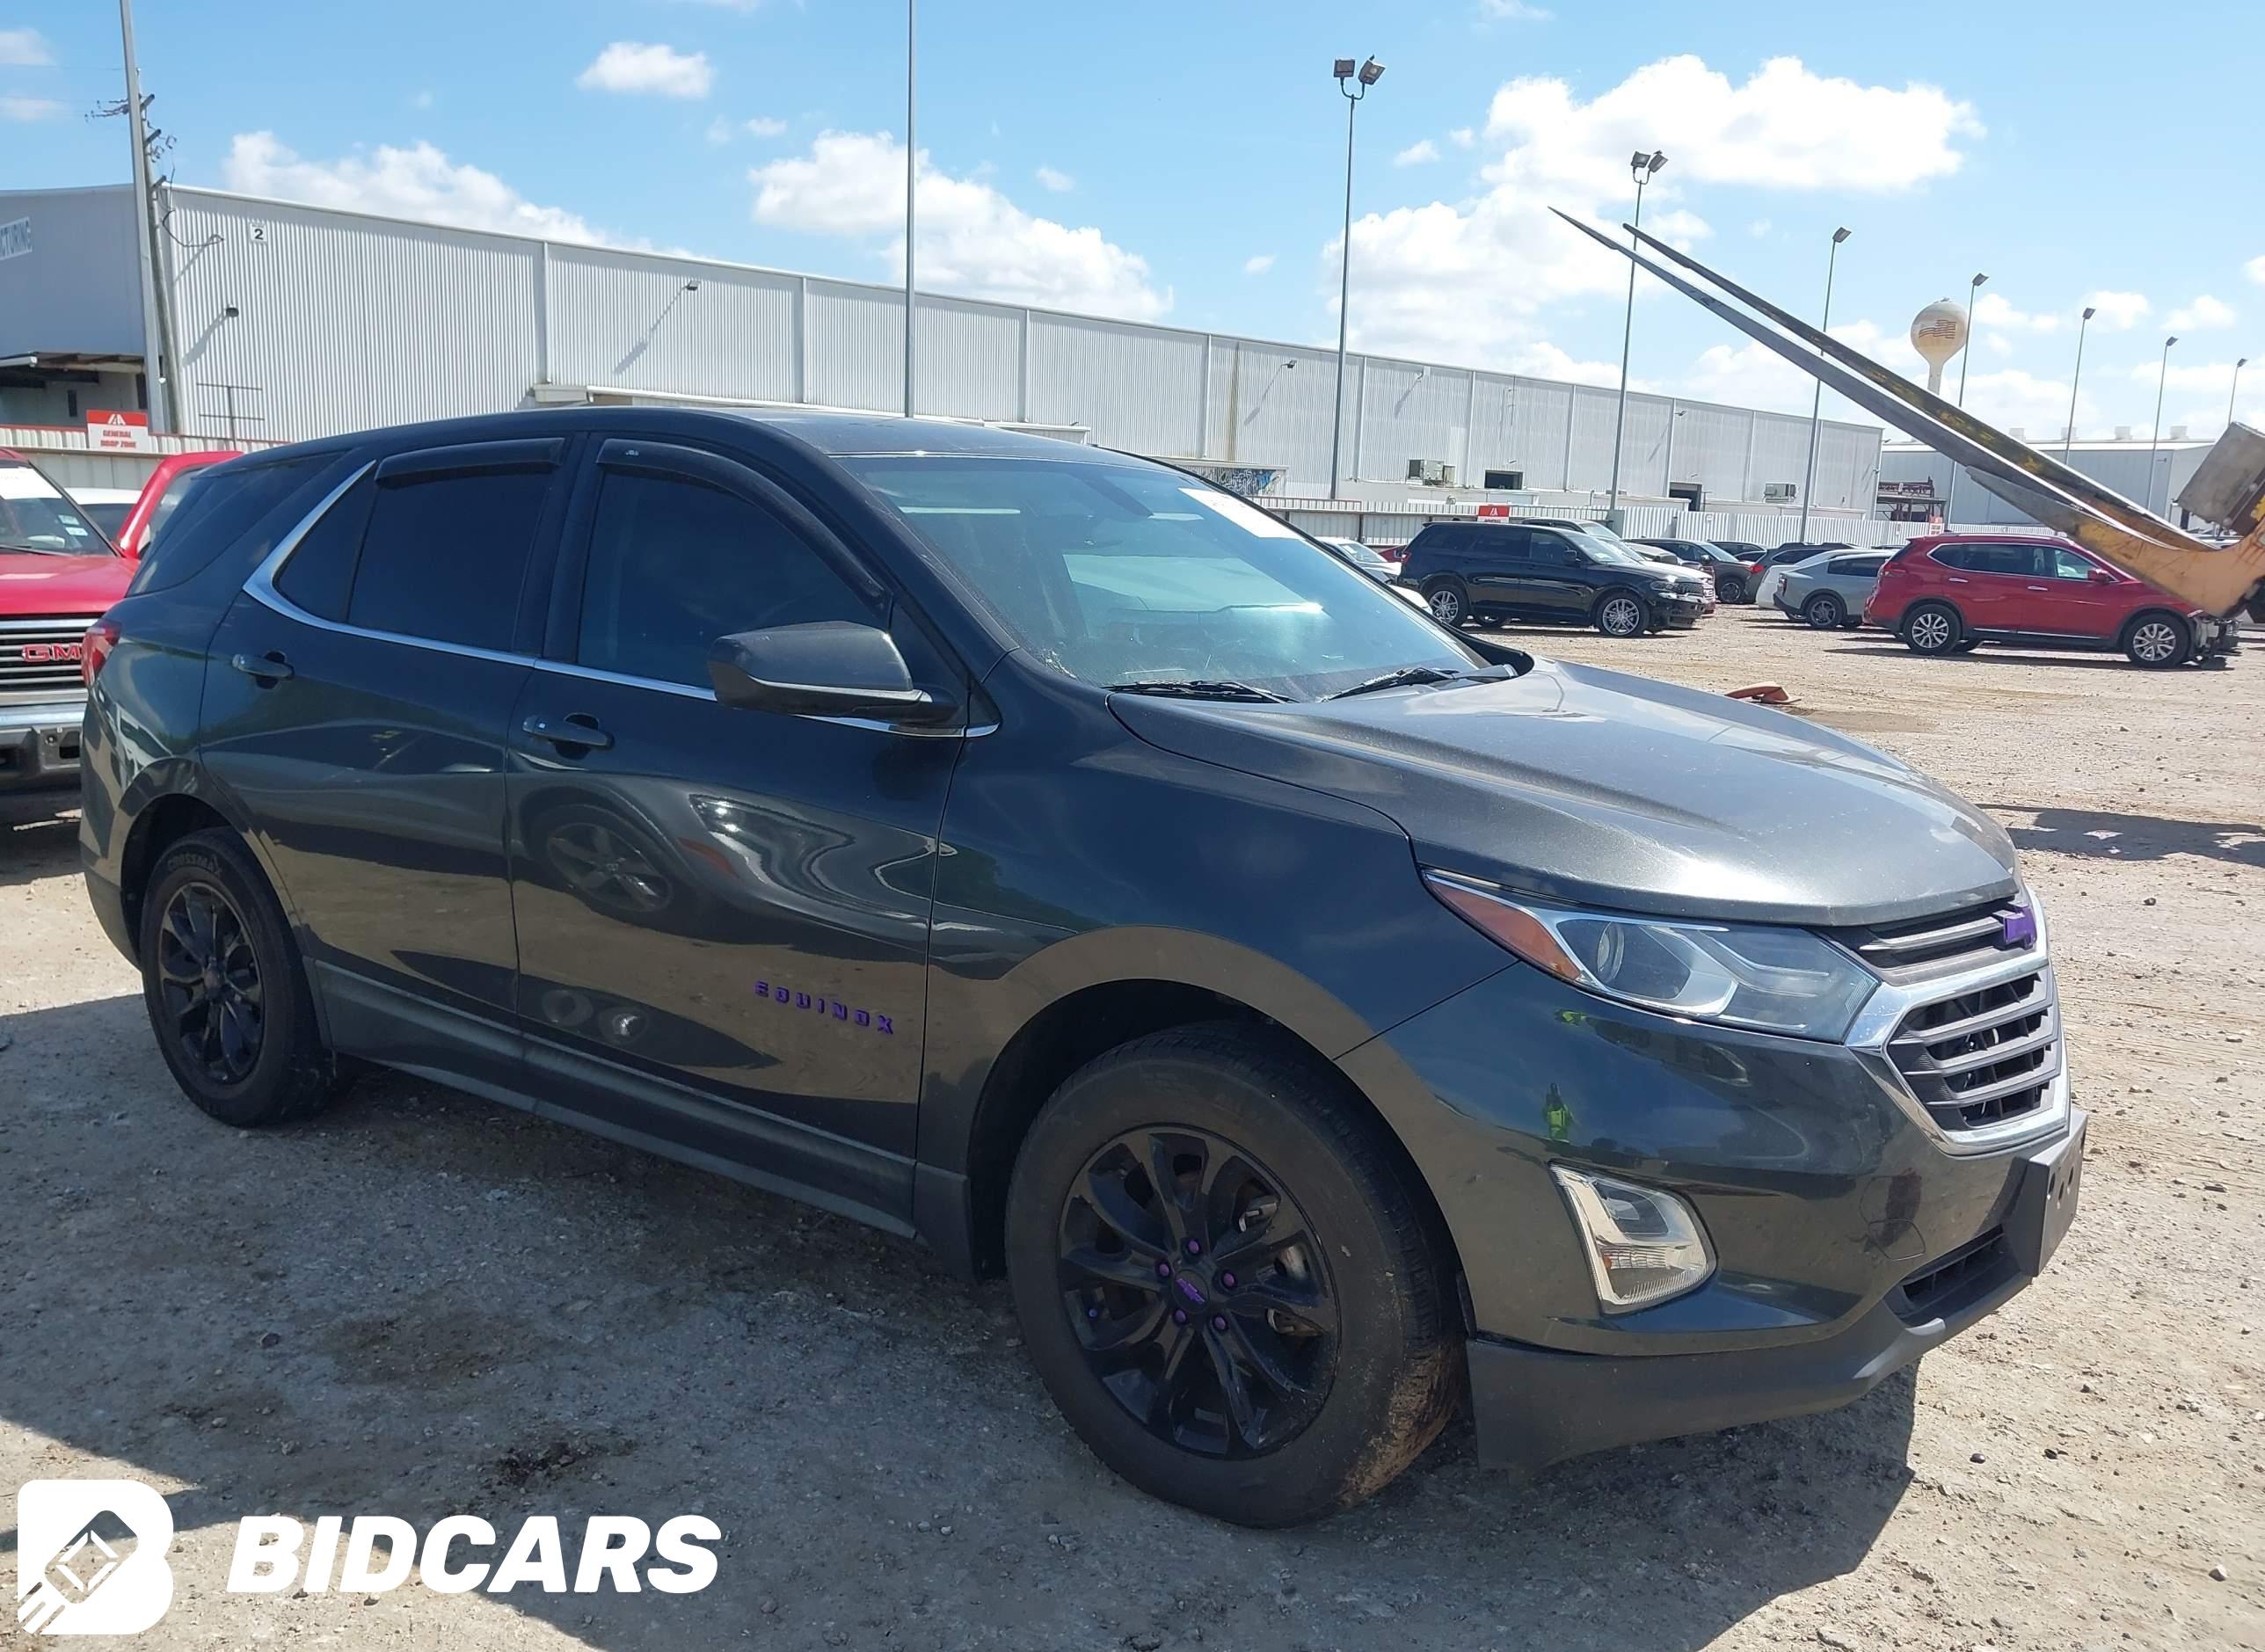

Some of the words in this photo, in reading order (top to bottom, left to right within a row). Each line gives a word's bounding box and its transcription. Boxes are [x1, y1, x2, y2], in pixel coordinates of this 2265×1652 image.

[254, 228, 264, 240] 2
[22, 643, 83, 662] GM
[754, 979, 894, 1035] EQUINOX
